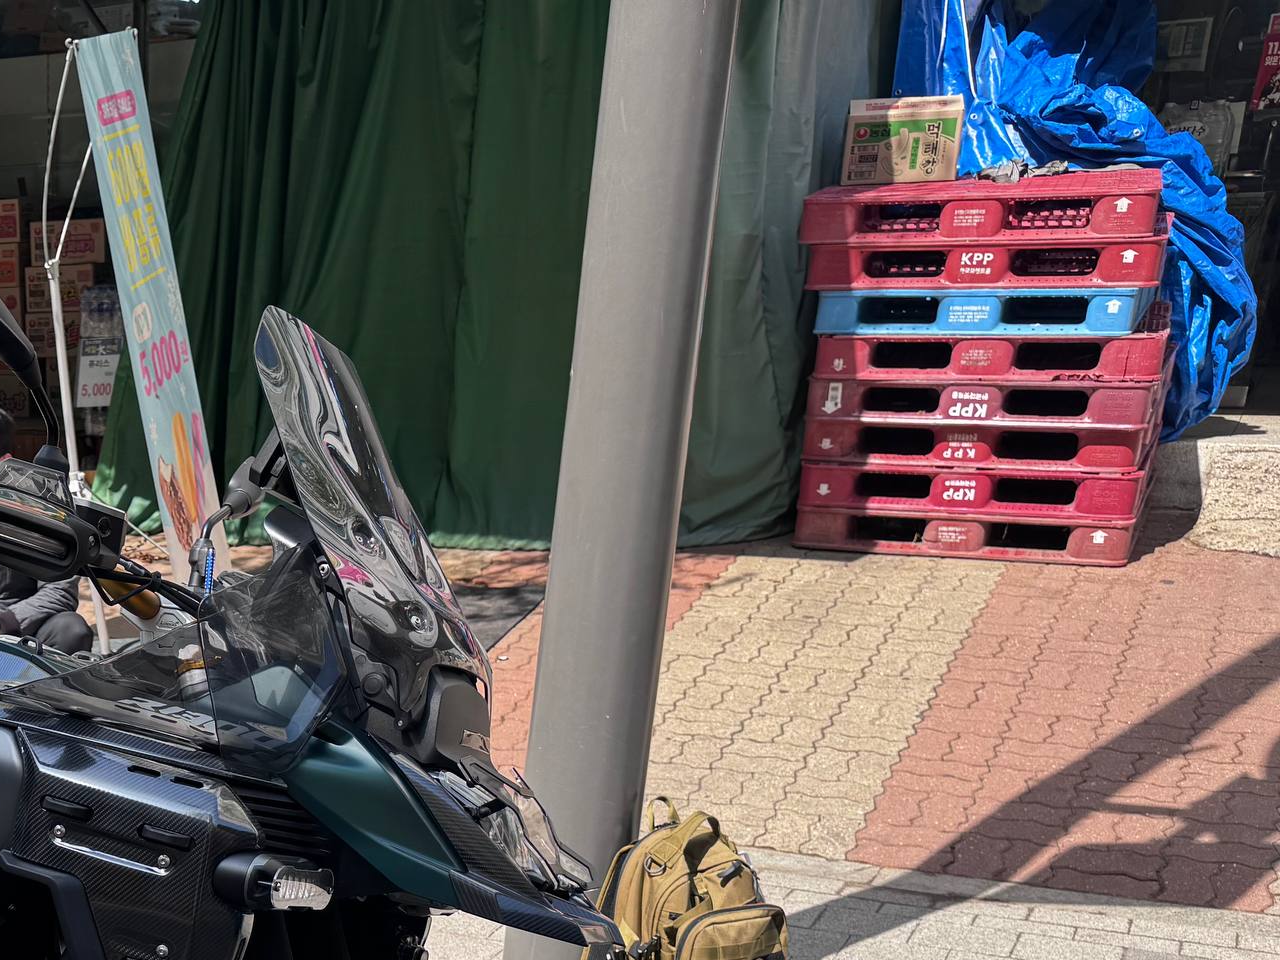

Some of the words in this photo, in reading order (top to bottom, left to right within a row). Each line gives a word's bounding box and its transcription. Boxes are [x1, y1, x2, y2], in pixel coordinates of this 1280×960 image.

[960, 252, 994, 265] KPP
[948, 402, 988, 418] KPP
[942, 488, 976, 501] KPP
